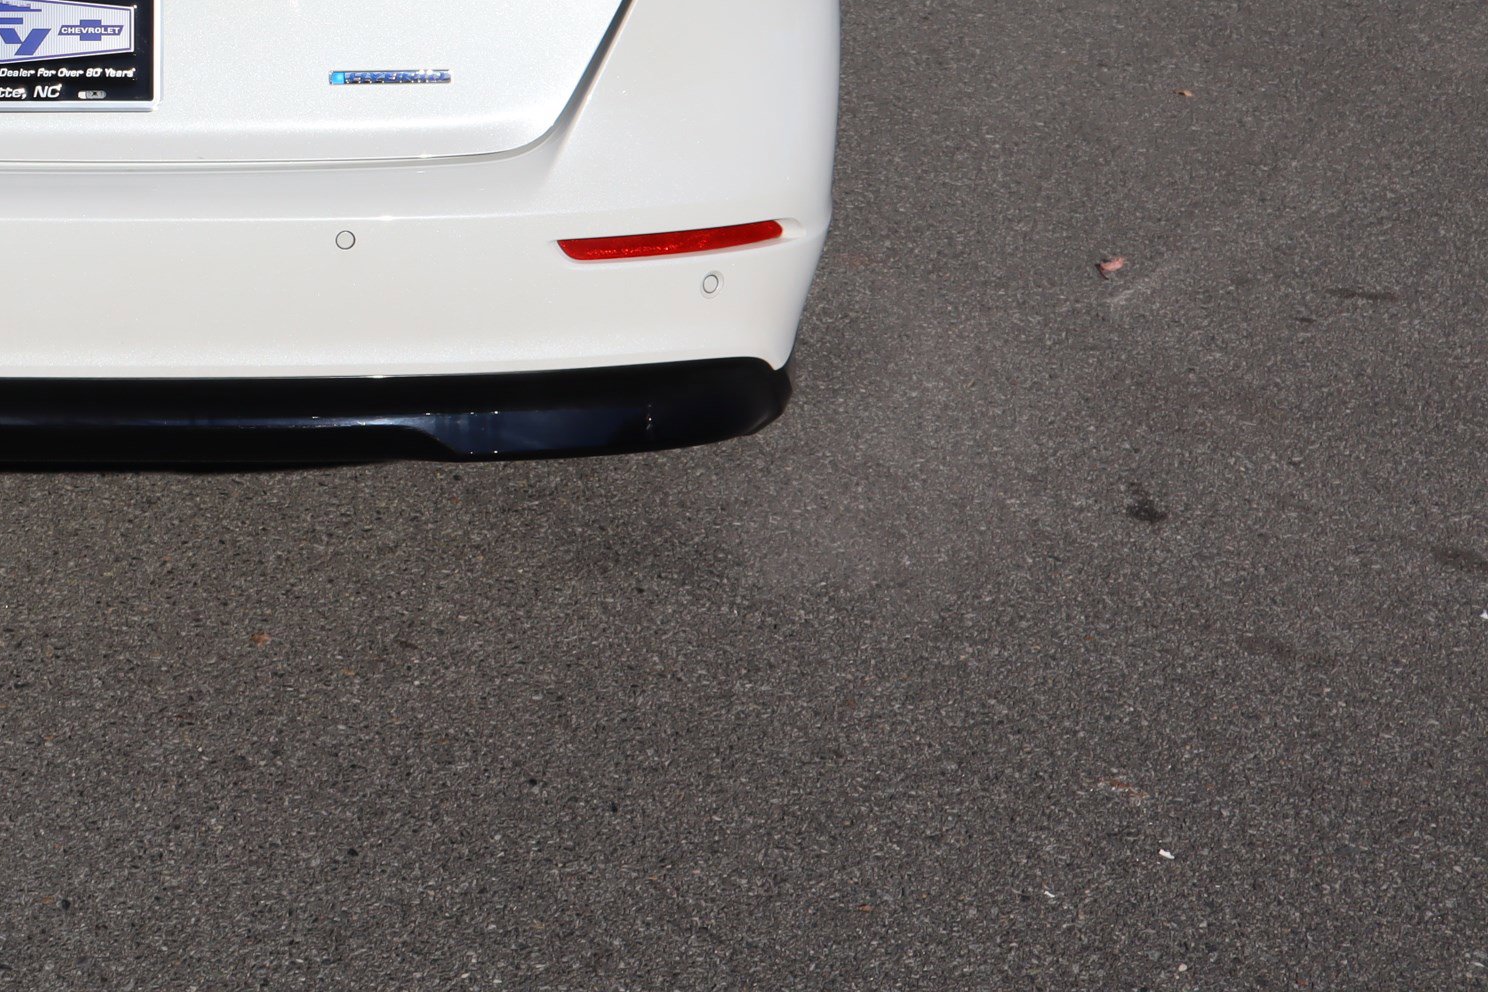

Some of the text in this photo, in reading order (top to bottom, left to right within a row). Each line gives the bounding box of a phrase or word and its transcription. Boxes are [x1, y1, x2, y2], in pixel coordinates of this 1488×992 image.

[60, 25, 121, 35] CHEVROLET
[0, 68, 35, 78] Dealer
[37, 68, 56, 77] For
[57, 68, 84, 78] Over
[33, 84, 62, 99] NC
